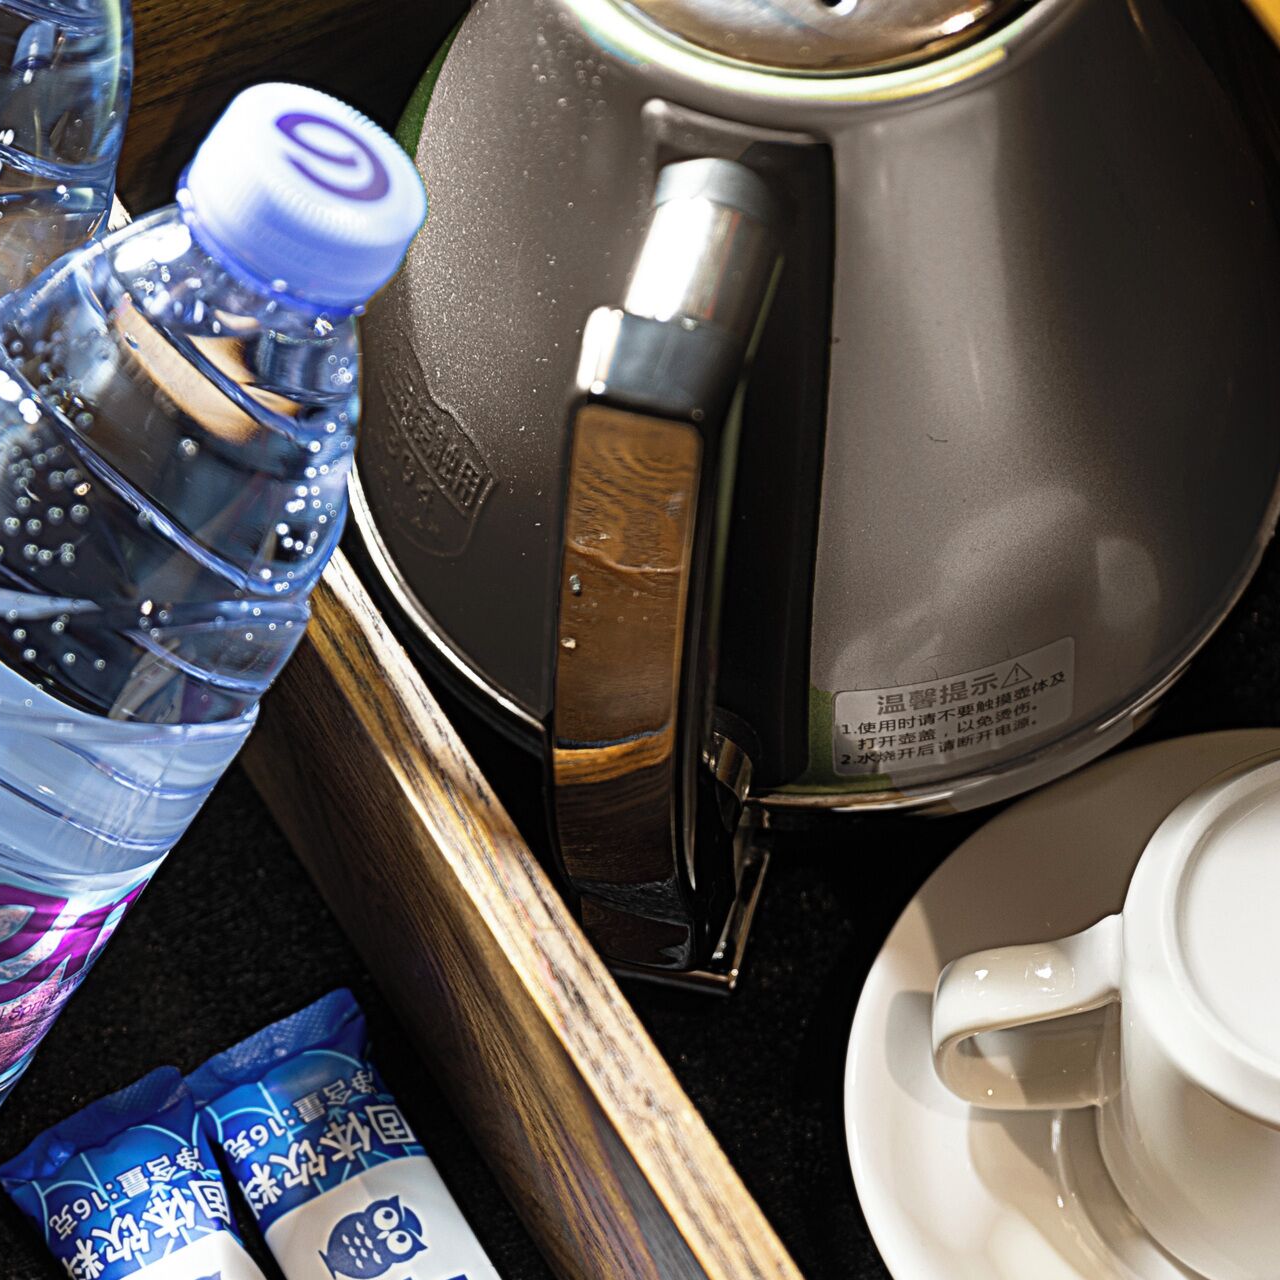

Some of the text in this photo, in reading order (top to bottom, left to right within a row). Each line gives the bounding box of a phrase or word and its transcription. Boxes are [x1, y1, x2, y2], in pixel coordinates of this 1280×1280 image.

[876, 673, 998, 716] 温馨提示
[237, 1103, 417, 1220] 固体饮料
